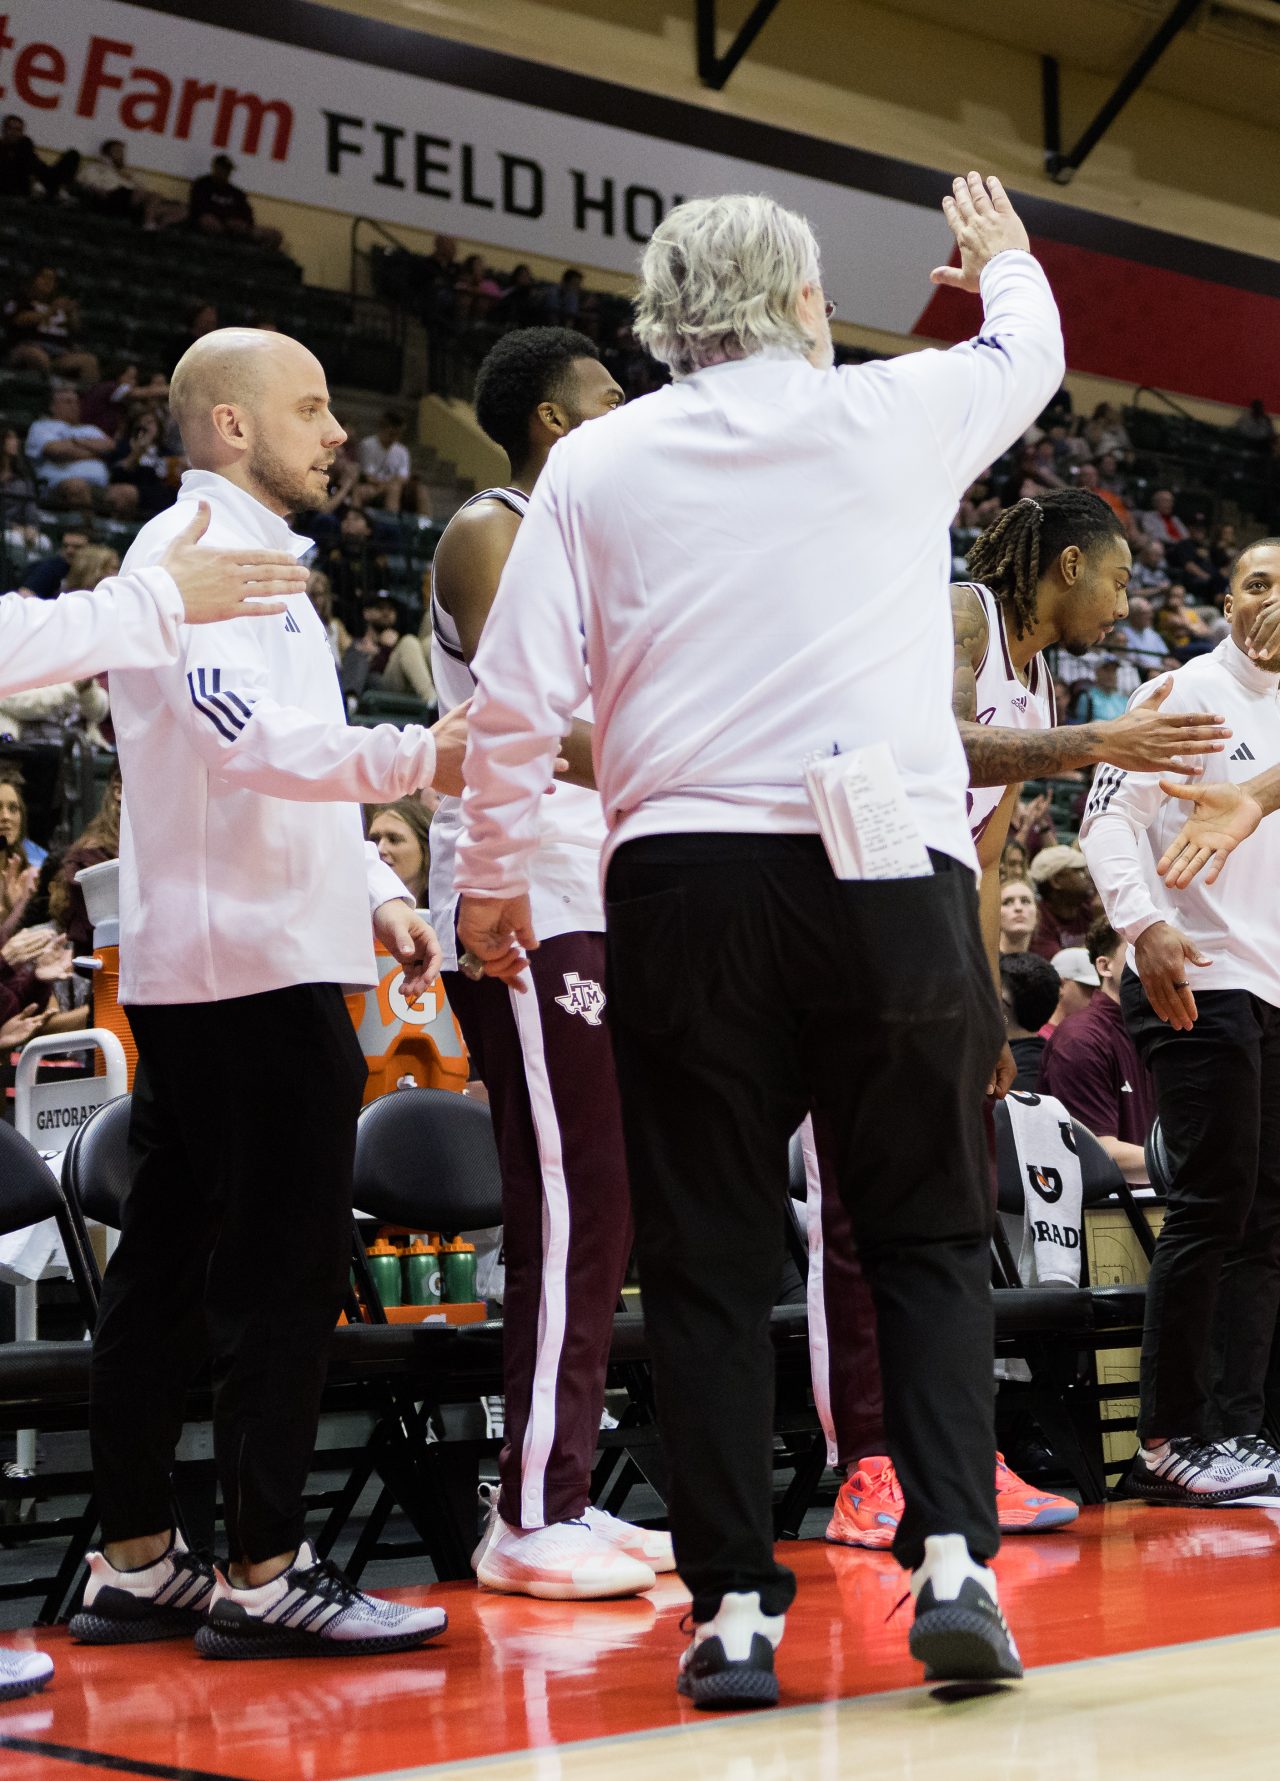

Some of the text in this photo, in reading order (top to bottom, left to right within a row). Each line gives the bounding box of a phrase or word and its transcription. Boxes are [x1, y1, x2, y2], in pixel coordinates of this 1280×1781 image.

[321, 109, 546, 220] FIELD
[568, 167, 686, 245] HO
[37, 1103, 104, 1130] GATORA
[1031, 1220, 1082, 1249] RAD
